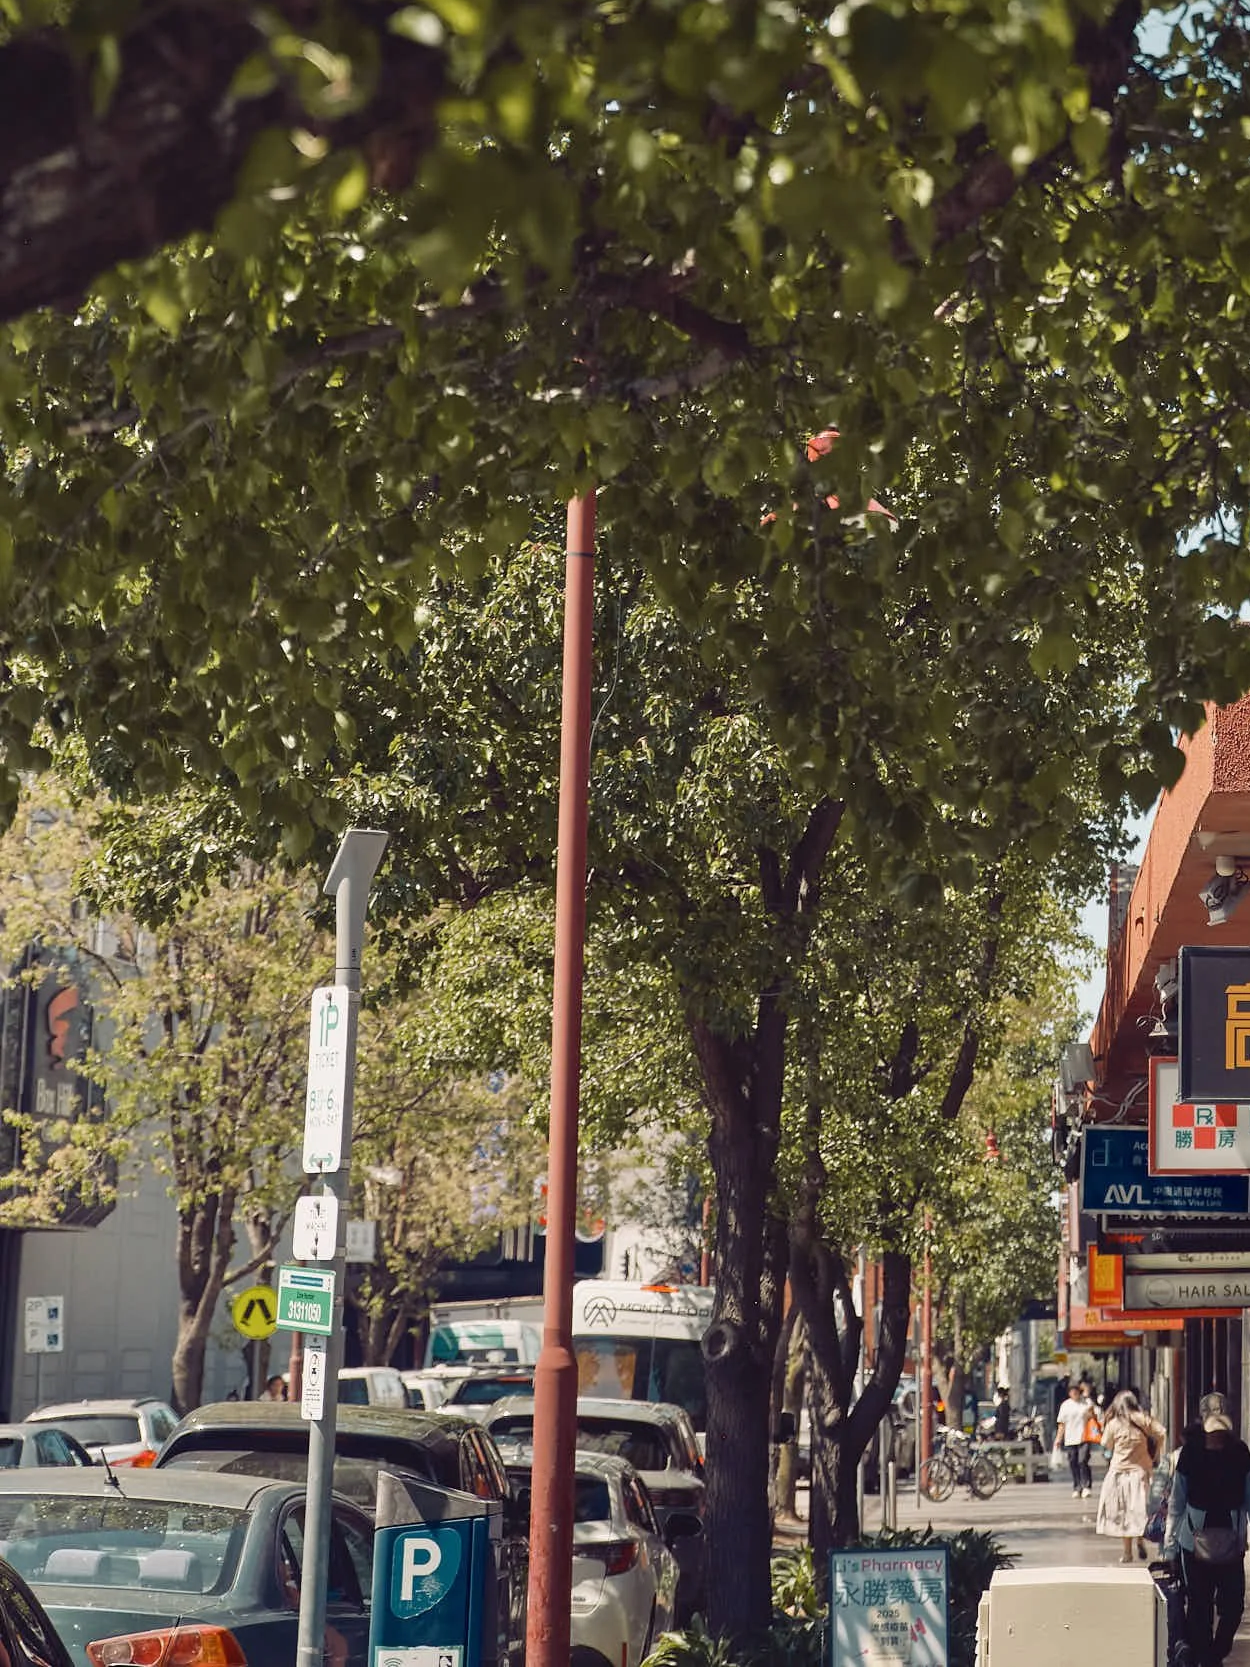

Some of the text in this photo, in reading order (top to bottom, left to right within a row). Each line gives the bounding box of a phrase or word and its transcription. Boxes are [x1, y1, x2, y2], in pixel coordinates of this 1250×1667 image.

[319, 1005, 339, 1046] 1P
[1104, 1184, 1150, 1205] AVL
[1178, 1285, 1217, 1298] HAIR
[401, 1538, 442, 1600] P
[861, 1558, 943, 1574] Pharmacy
[834, 1577, 944, 1608] 永勝藥房
